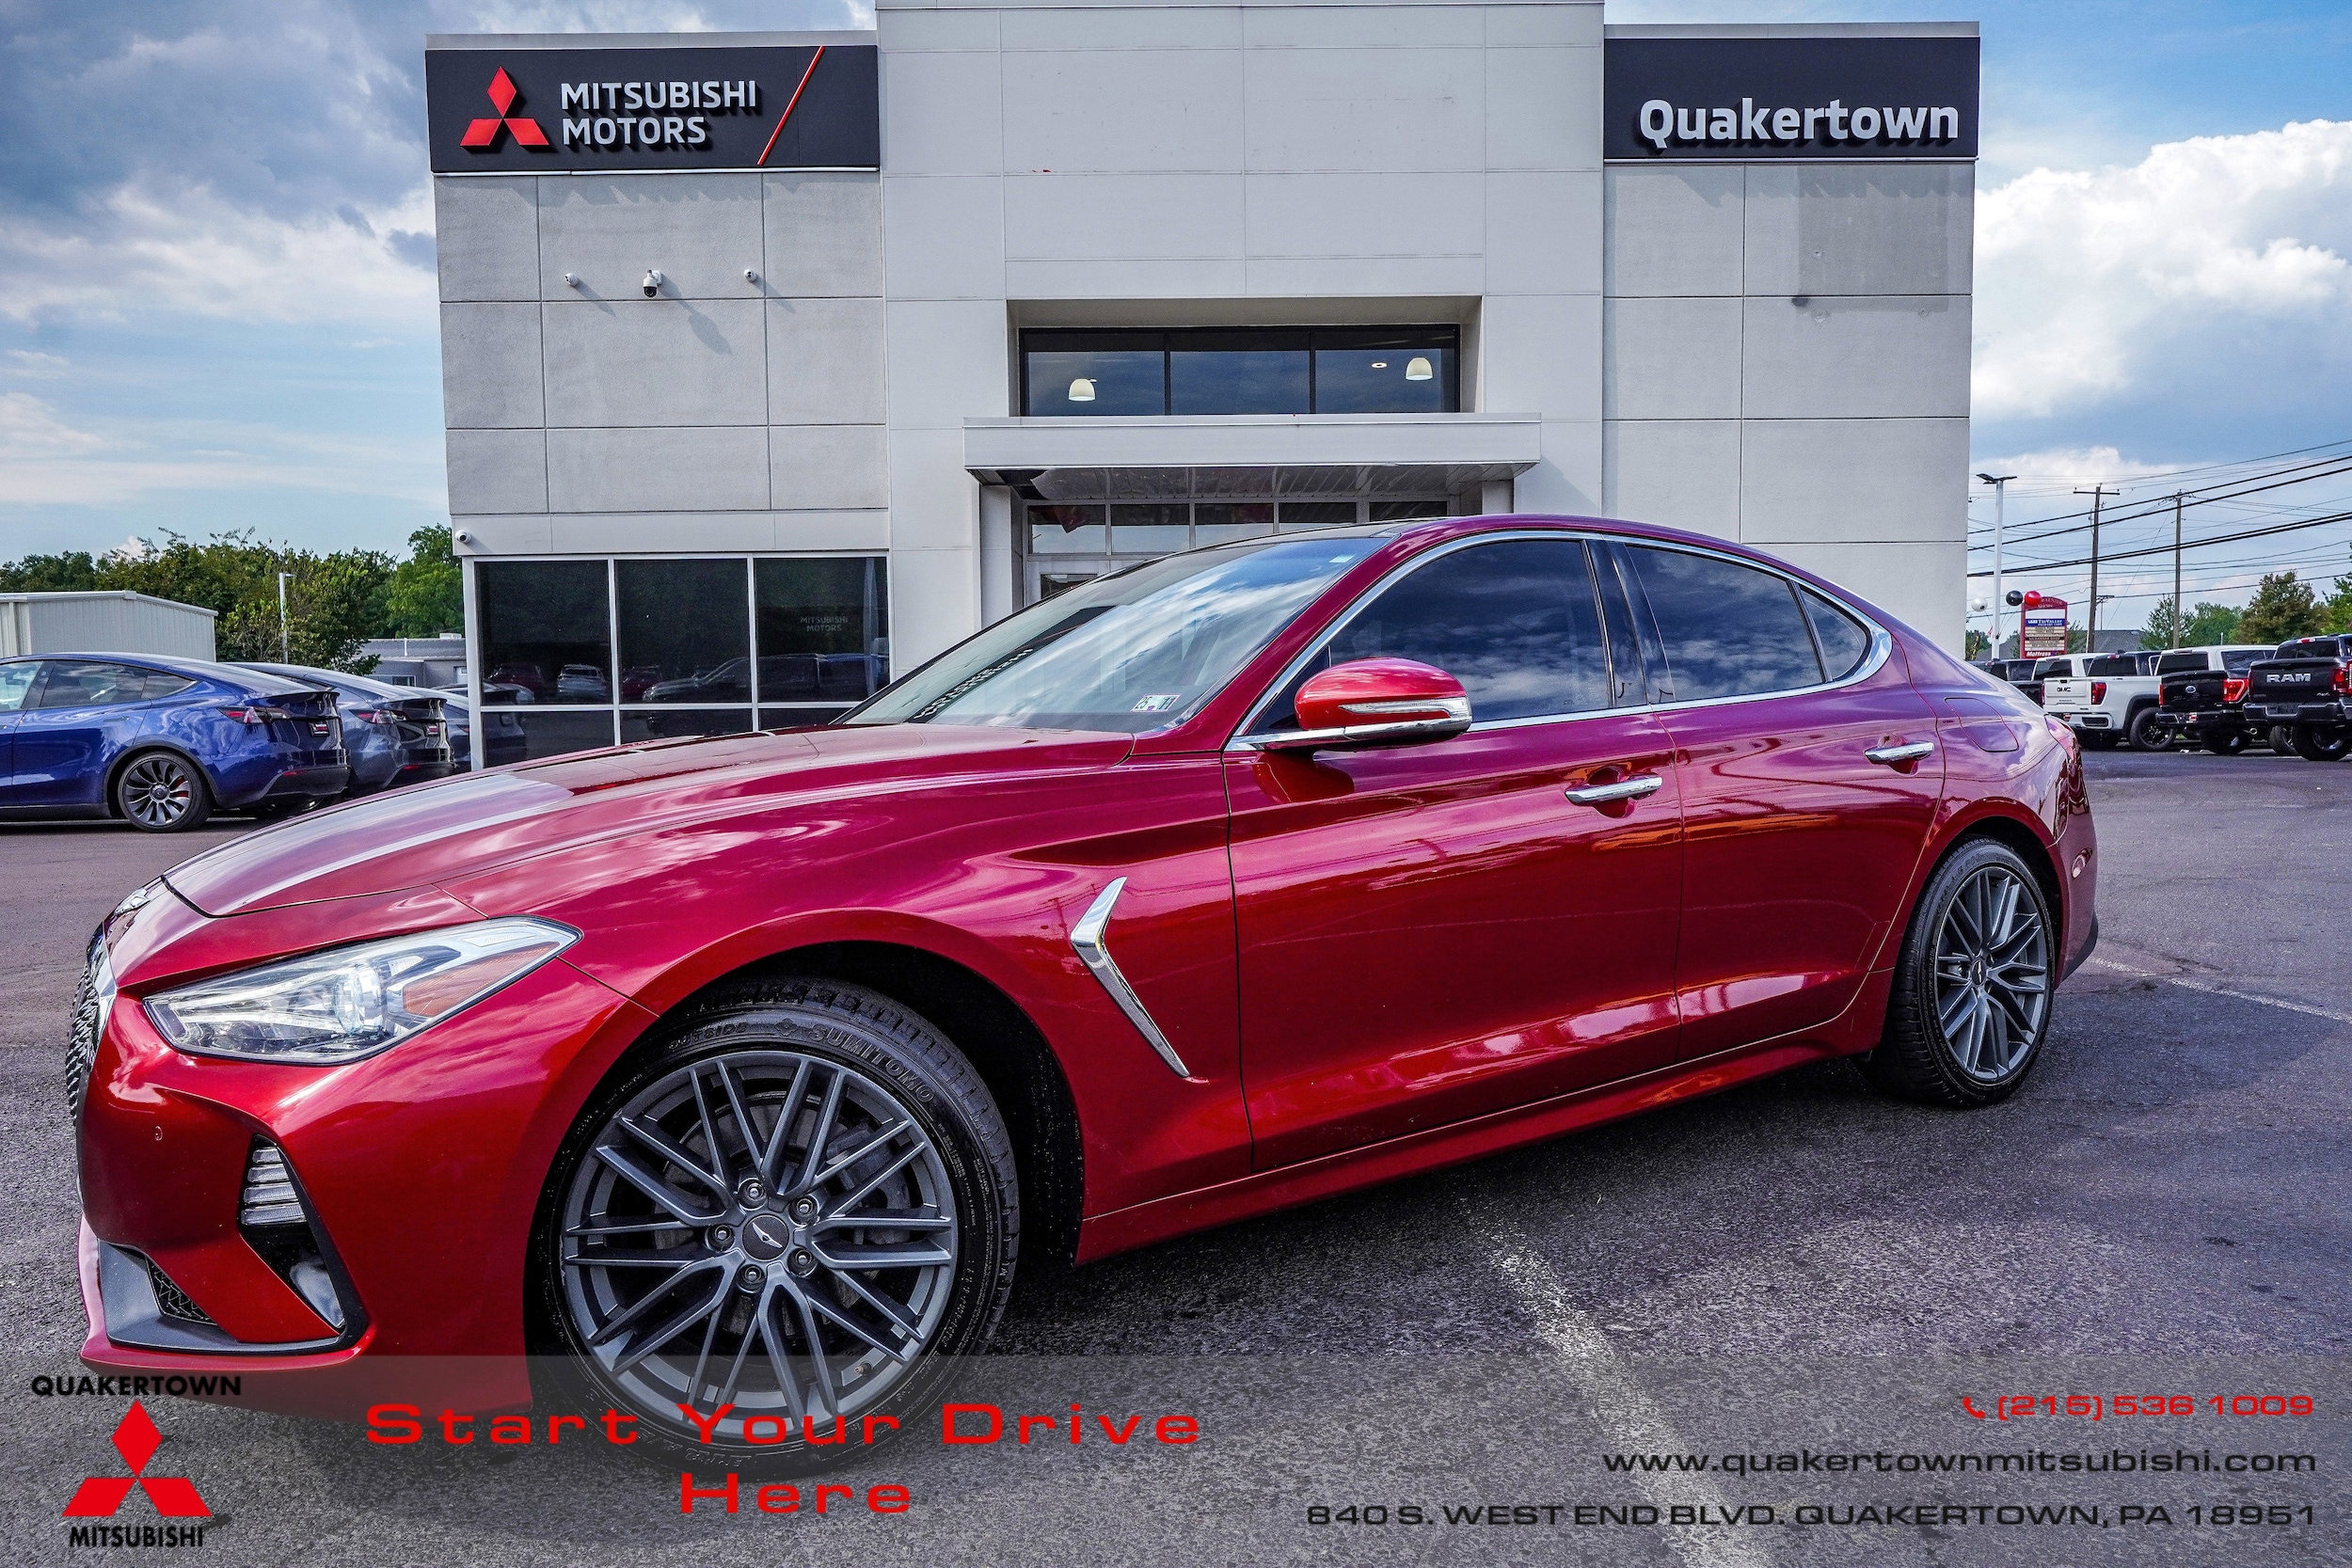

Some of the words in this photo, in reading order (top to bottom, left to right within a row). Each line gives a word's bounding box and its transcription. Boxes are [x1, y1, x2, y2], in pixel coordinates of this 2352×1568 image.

[561, 81, 755, 109] MITSUBISHI
[563, 116, 707, 144] MOTORS
[1639, 98, 1960, 149] Quakertown
[2266, 673, 2312, 683] RAM
[1135, 696, 1153, 709] 25
[1158, 697, 1177, 709] 11
[668, 1021, 750, 1050] OUTSIDE
[807, 1022, 936, 1104] SUMITOMO
